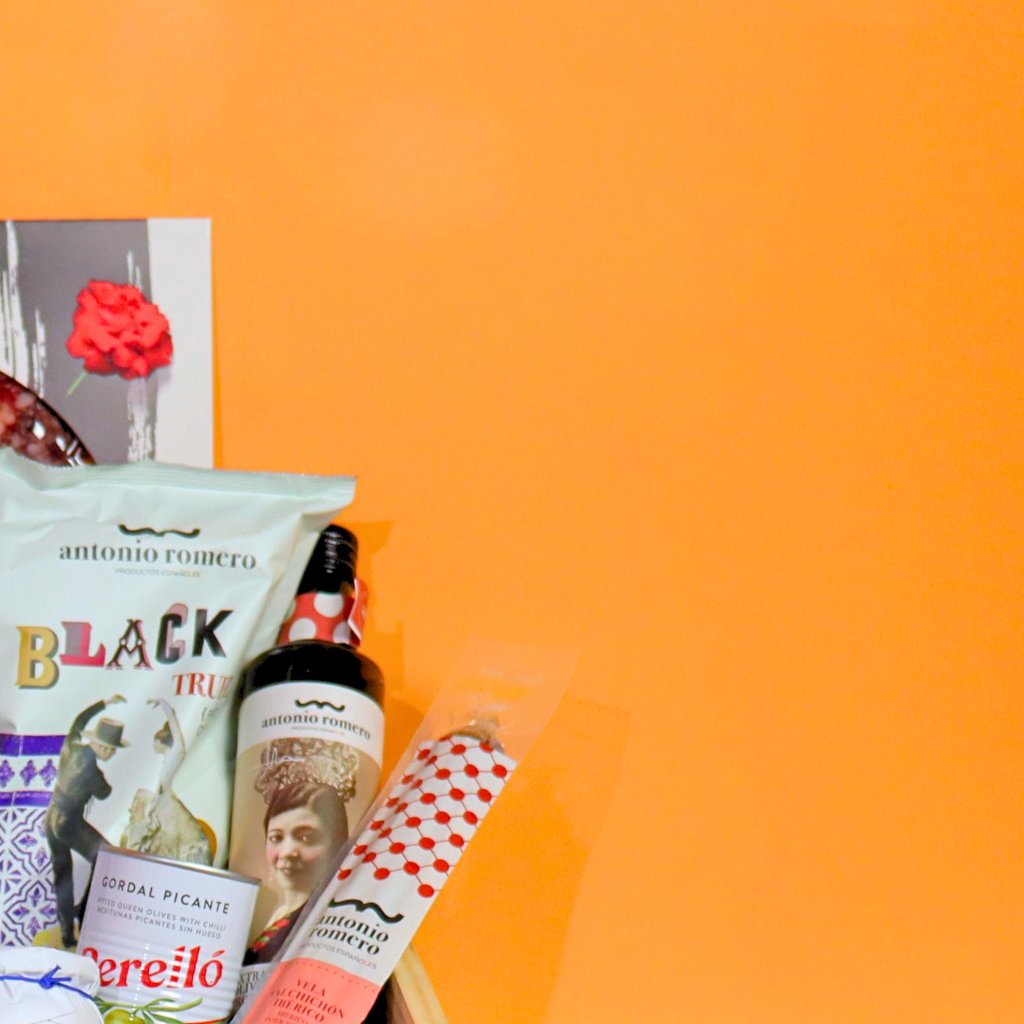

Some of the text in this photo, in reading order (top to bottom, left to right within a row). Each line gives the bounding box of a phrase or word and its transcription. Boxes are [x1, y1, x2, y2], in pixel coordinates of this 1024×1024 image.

[59, 539, 257, 570] antonio romero
[14, 602, 233, 690] BLACK
[262, 710, 318, 729] antonio
[321, 715, 371, 740] romero
[101, 876, 231, 915] GORDAL PICANTE
[117, 902, 144, 913] QUEEN
[146, 908, 176, 921] OLIVES
[179, 916, 201, 926] WITH
[135, 916, 176, 930] PICANTES
[179, 925, 193, 933] SIN
[196, 928, 221, 940] HUESO
[309, 928, 380, 955] romero
[295, 979, 326, 998] VELA
[273, 988, 347, 1020] ALCHICHÓN
